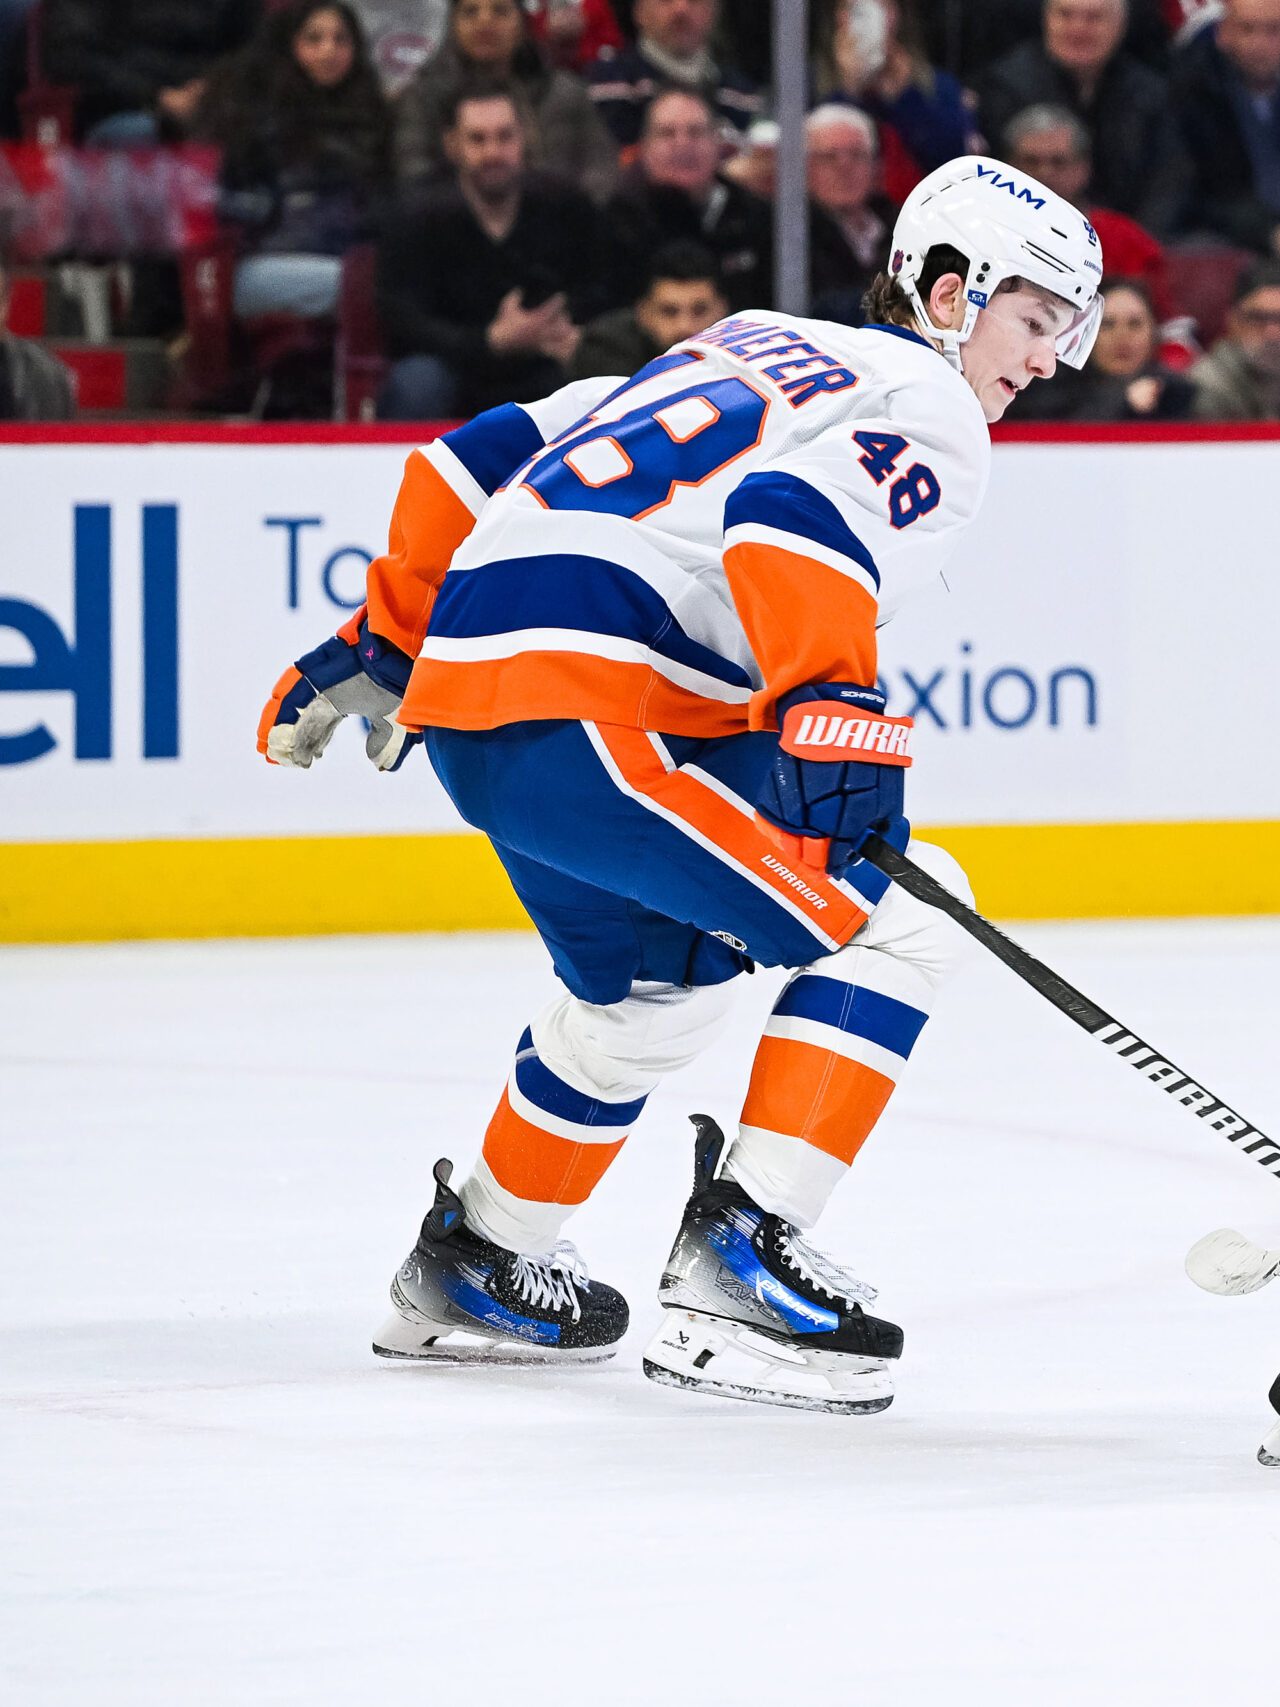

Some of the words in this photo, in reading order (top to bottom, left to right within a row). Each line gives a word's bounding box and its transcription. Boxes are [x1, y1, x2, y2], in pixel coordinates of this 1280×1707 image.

[977, 164, 1047, 210] VIAM
[852, 430, 941, 530] 48
[263, 516, 376, 612] To
[0, 502, 180, 766] ell
[877, 641, 1097, 730] xion
[794, 715, 911, 756] WARR
[760, 854, 829, 911] WARRIOR
[759, 1279, 828, 1326] BAUER
